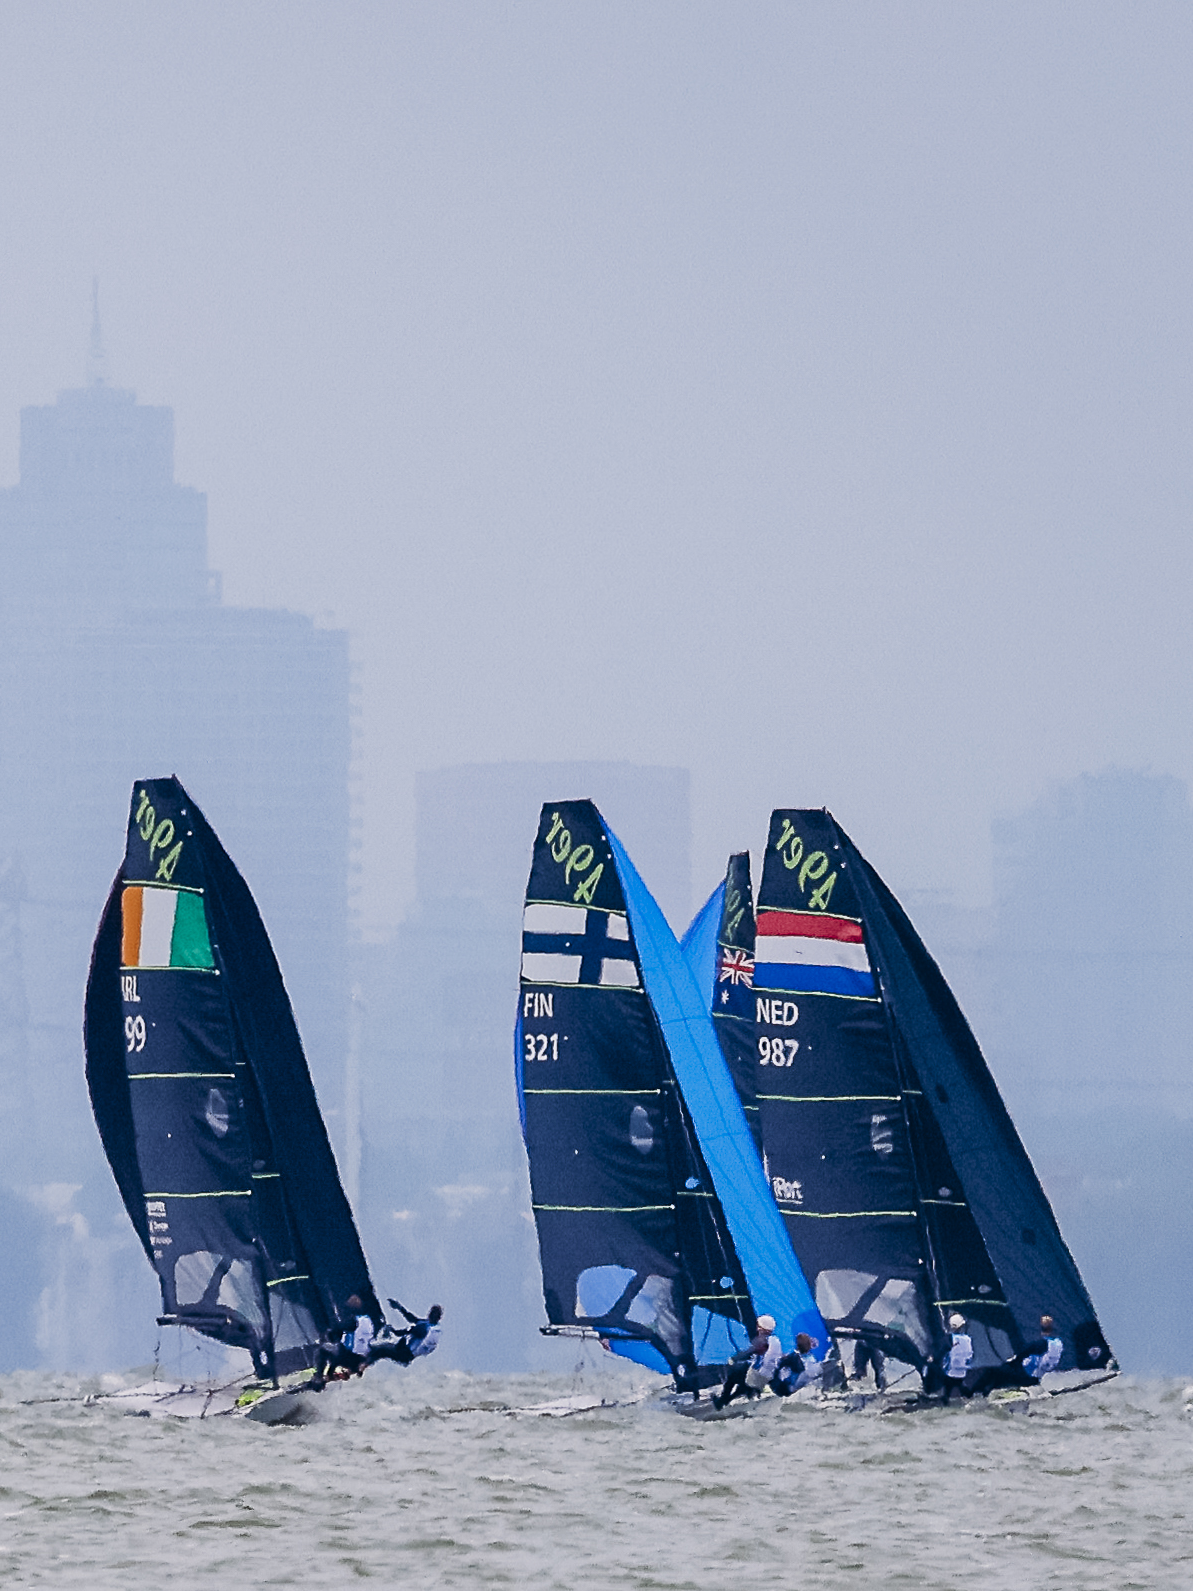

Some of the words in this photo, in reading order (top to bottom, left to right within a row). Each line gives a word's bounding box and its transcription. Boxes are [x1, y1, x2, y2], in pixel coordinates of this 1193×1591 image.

[121, 975, 141, 1002] IRL
[524, 992, 554, 1018] FIN
[756, 997, 799, 1026] NED
[124, 1015, 147, 1053] 99
[524, 1033, 559, 1062] 321
[758, 1036, 800, 1067] 987
